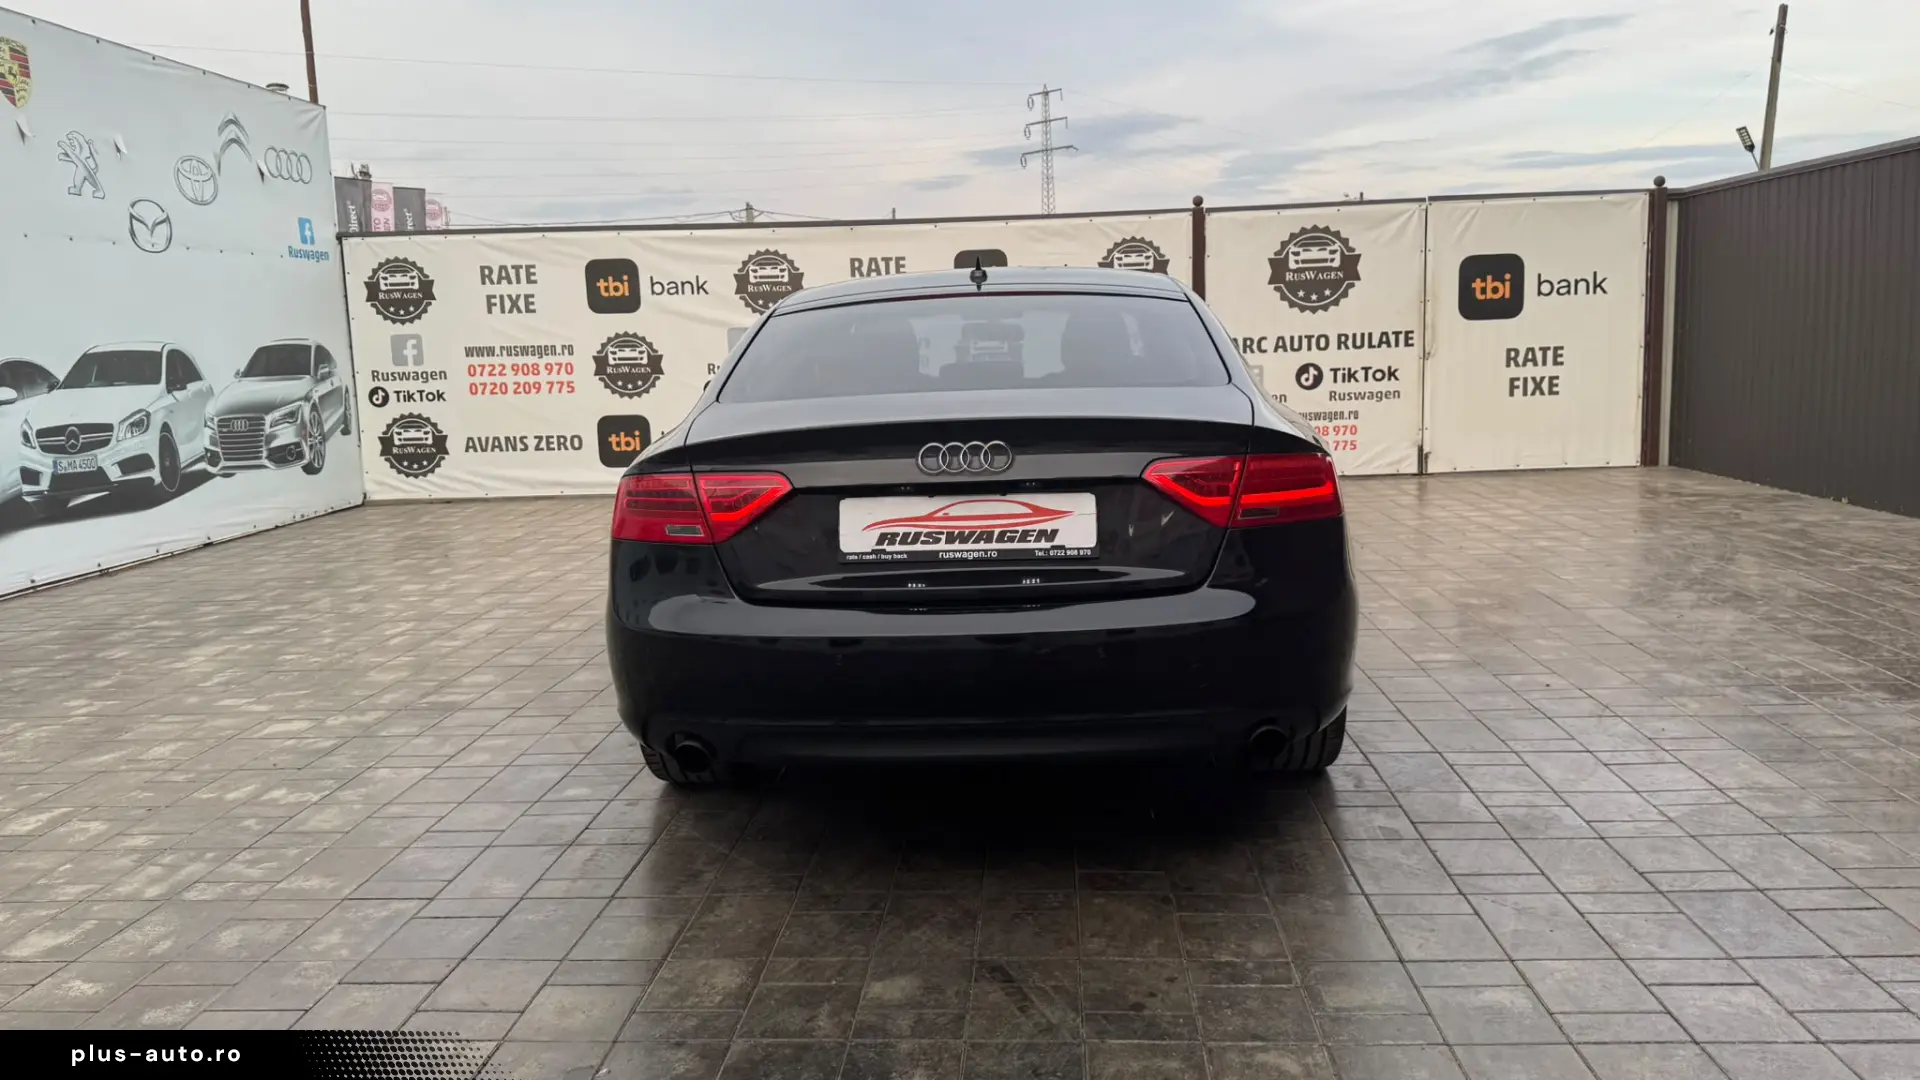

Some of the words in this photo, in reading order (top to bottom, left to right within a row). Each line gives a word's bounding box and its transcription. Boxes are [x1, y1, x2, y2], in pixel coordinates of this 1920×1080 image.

[288, 246, 330, 263] Ruswagen
[479, 264, 539, 286] RATE
[849, 256, 907, 278] RATE
[596, 275, 630, 298] tbi
[650, 275, 709, 297] bank
[1471, 273, 1512, 300] tbi
[1537, 271, 1609, 297] bank
[486, 294, 537, 315] FIXE
[1273, 334, 1331, 353] AUTO
[1336, 330, 1416, 350] RULATE
[464, 344, 575, 359] www.ruswagen.ro
[1505, 346, 1565, 368] RATE
[371, 369, 448, 384] Ruswagen
[467, 364, 507, 377] 0722
[511, 363, 541, 376] 908
[544, 362, 574, 376] 970
[1329, 366, 1400, 384] TikTok
[469, 382, 508, 396] 0720
[513, 381, 542, 395] 209
[546, 380, 575, 394] 775
[1508, 375, 1560, 397] FIXE
[393, 389, 447, 403] TikTok
[1329, 389, 1401, 403] Ruswagen
[1333, 425, 1358, 436] 970
[465, 435, 529, 453] AVANS
[533, 434, 583, 451] ZERO
[608, 431, 642, 452] tbi
[1333, 440, 1357, 451] 775
[875, 528, 1060, 547] RUSWAGEN
[938, 551, 998, 559] ruswagen.ro
